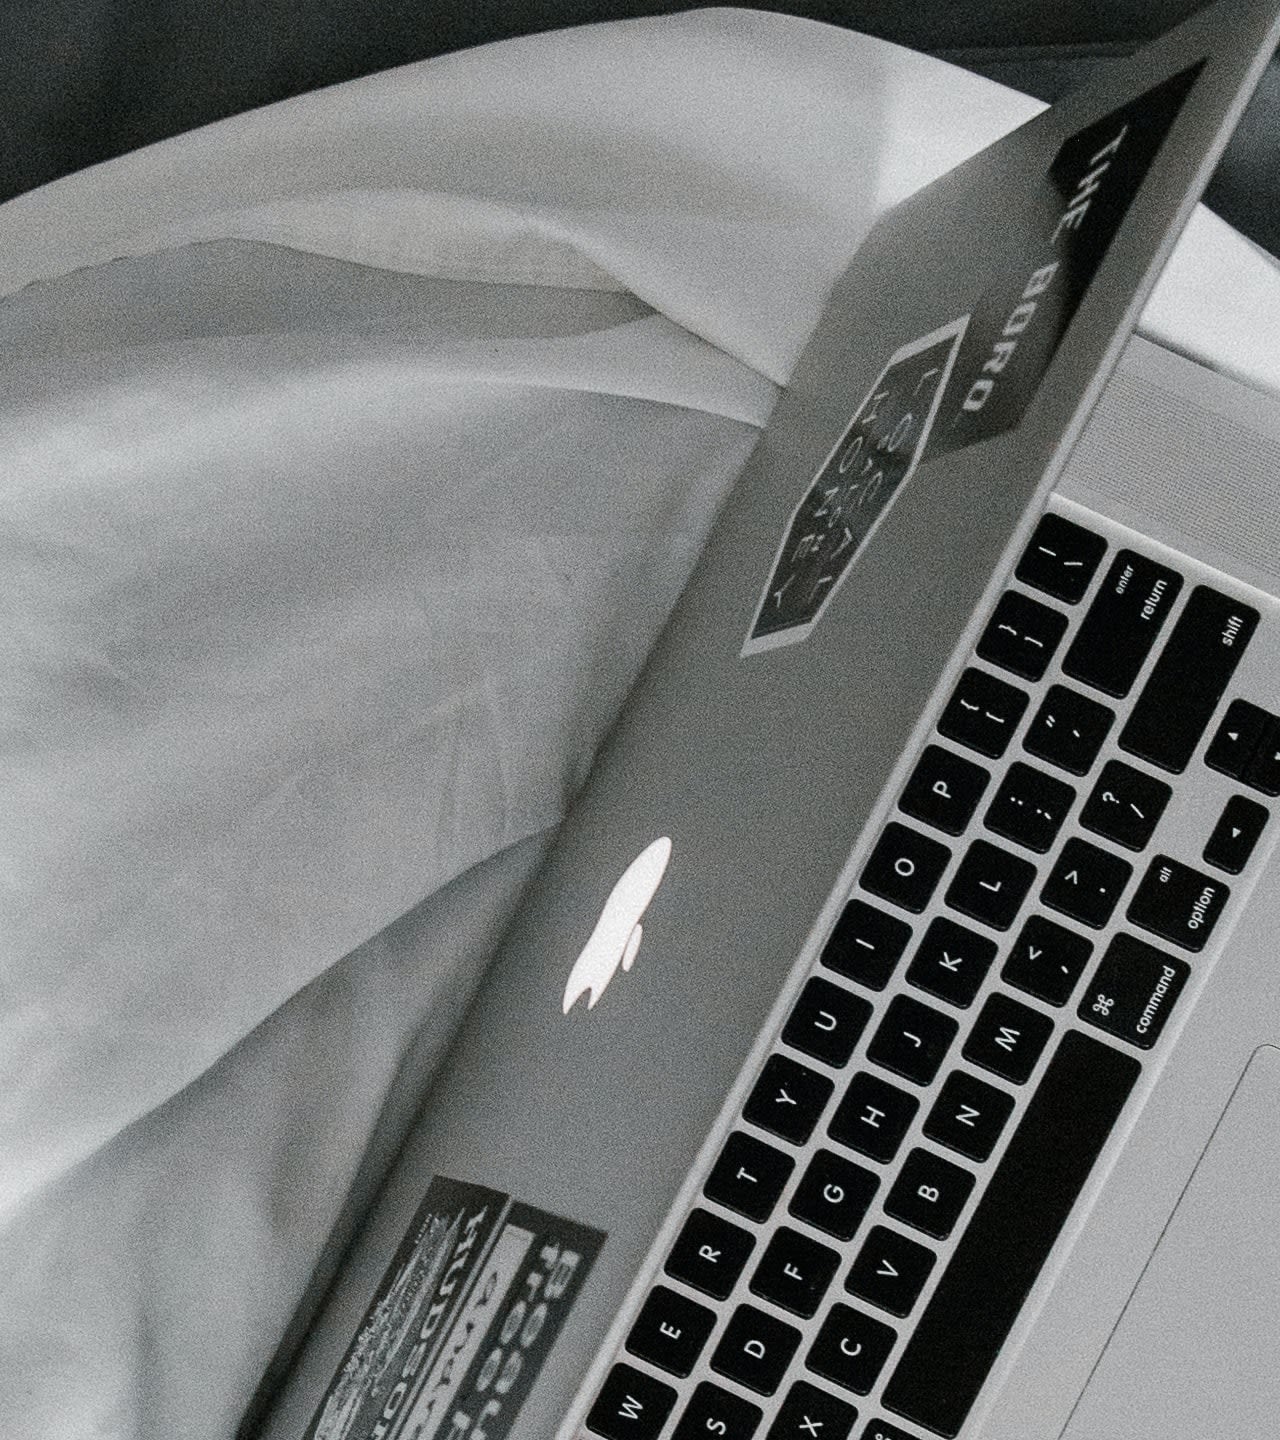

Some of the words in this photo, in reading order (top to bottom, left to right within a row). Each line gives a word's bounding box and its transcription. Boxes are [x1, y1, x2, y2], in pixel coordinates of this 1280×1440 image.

[1051, 125, 1128, 245] THE
[963, 262, 1061, 412] BORO
[804, 367, 939, 605] LOCAL
[772, 391, 890, 609] HONEY
[1116, 565, 1133, 594] enter
[1140, 579, 1167, 620] return
[1222, 615, 1243, 646] shift
[932, 780, 951, 799] P
[894, 857, 915, 877] O
[1159, 866, 1172, 883] alt
[979, 881, 1002, 892] L
[1187, 886, 1215, 929] option
[855, 938, 875, 950] I
[939, 951, 963, 972] K
[1136, 965, 1176, 1034] command
[814, 1010, 837, 1031] U
[903, 1031, 922, 1048] J
[994, 1026, 1021, 1052] M
[775, 1089, 797, 1105] Y
[860, 1105, 885, 1128] H
[955, 1104, 980, 1127] N
[736, 1167, 757, 1183] T
[823, 1183, 845, 1204] G
[917, 1184, 940, 1203] B
[698, 1244, 721, 1263] R
[783, 1263, 803, 1281] F
[876, 1259, 899, 1277] V
[476, 1242, 562, 1391] free
[659, 1321, 682, 1340] E
[743, 1339, 766, 1359] D
[840, 1337, 862, 1357] C
[618, 1395, 643, 1420] W
[706, 1417, 727, 1436] S
[799, 1415, 823, 1438] X
